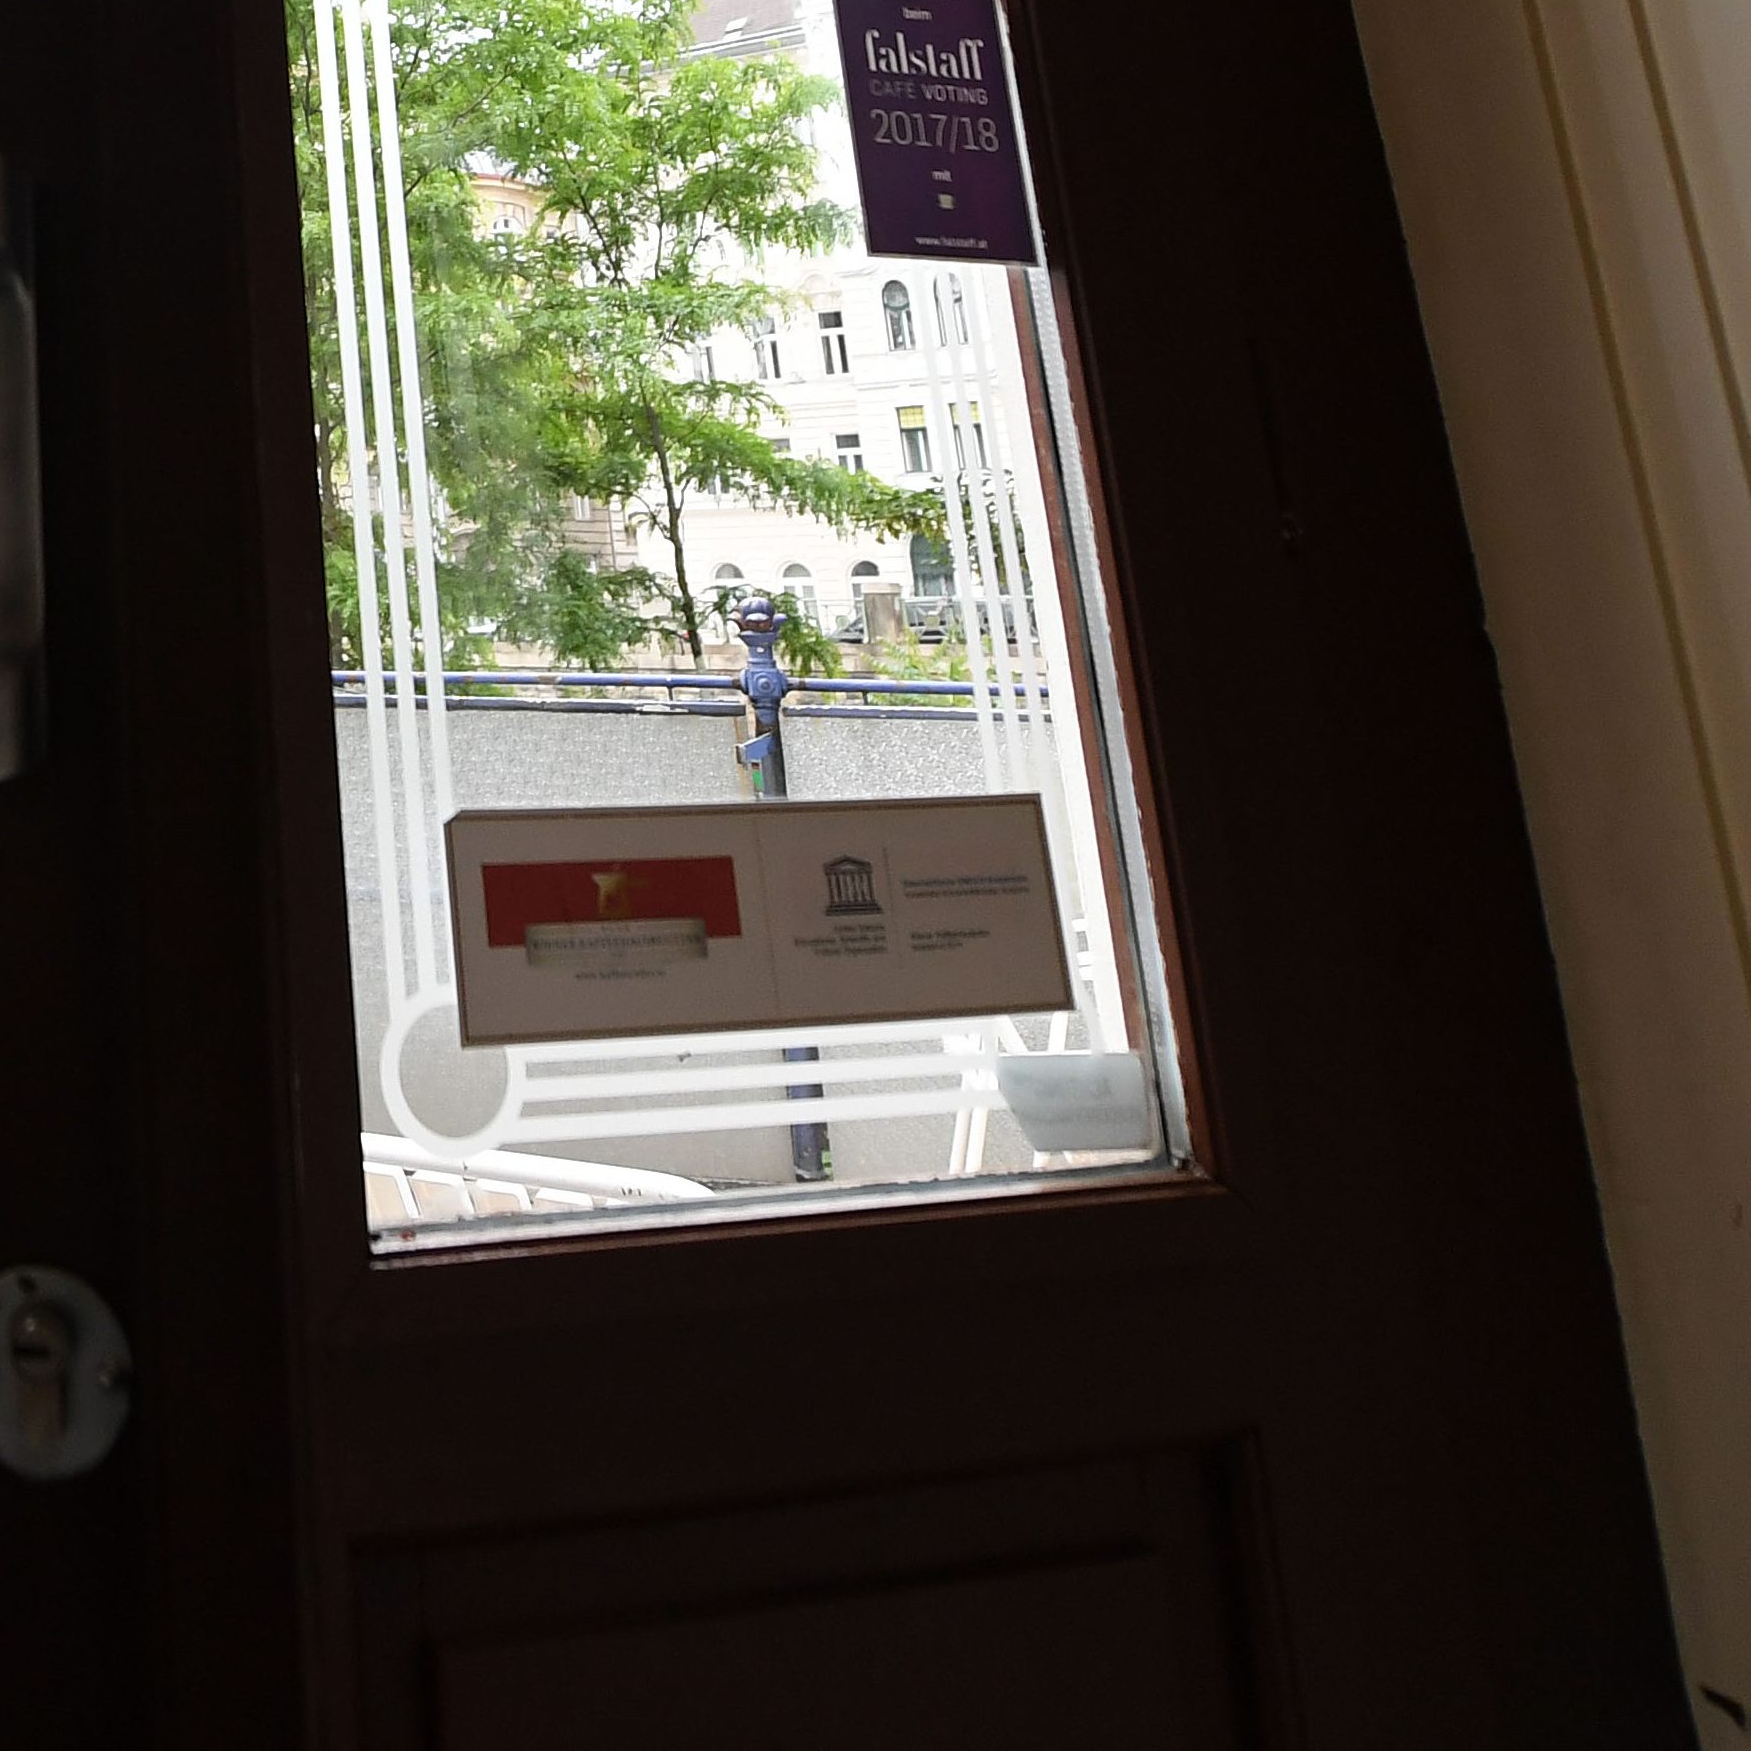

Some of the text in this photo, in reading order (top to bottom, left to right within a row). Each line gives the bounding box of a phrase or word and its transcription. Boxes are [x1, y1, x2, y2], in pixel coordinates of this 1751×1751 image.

[865, 29, 984, 81] falstaff
[921, 84, 989, 105] VOTING
[869, 108, 1000, 153] 2017/18
